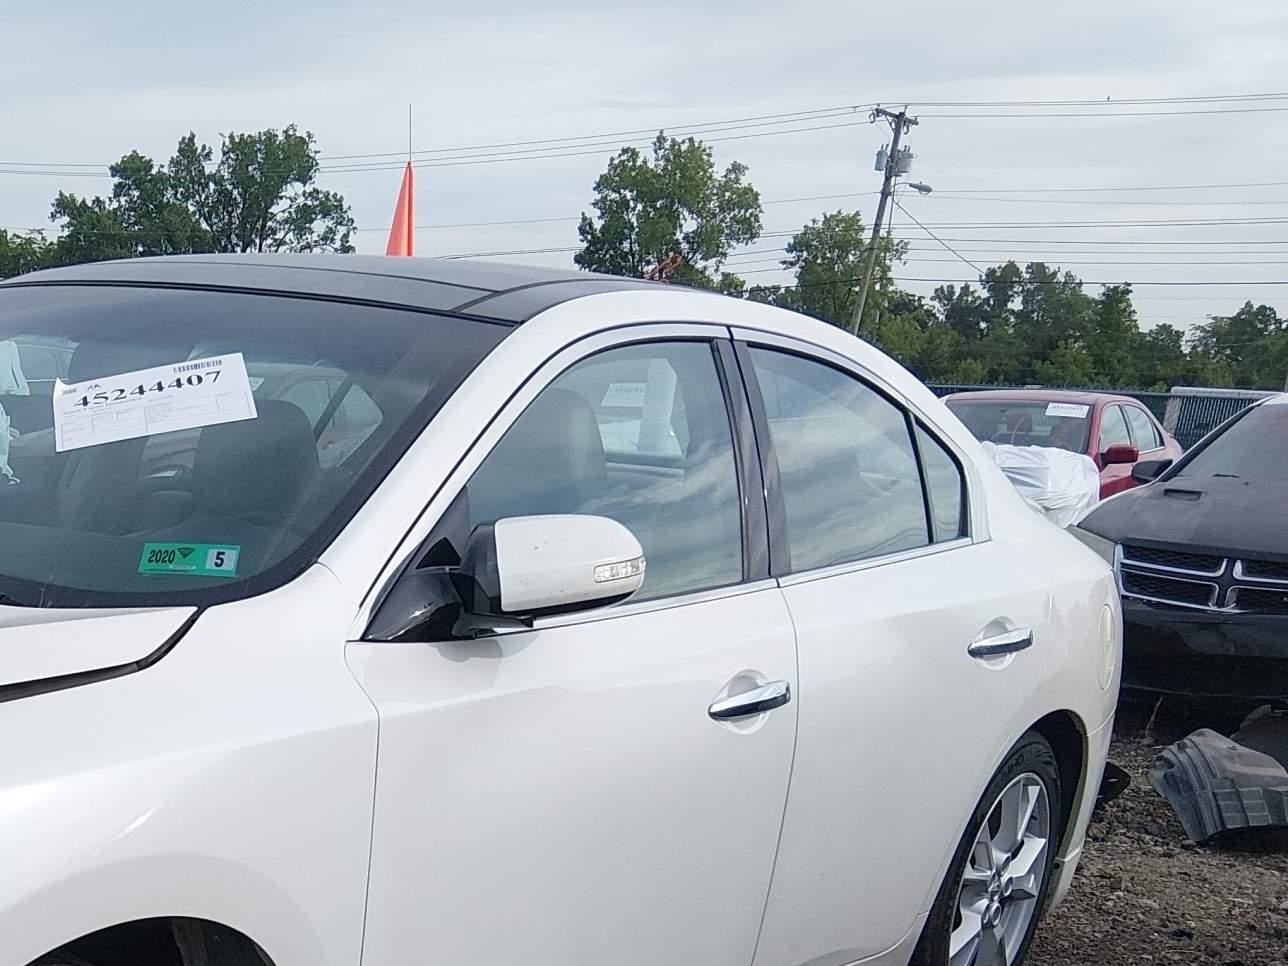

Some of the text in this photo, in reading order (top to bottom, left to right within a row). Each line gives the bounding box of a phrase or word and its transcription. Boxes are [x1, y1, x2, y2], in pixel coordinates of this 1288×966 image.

[72, 370, 222, 408] 45244407
[147, 549, 175, 565] 2020
[214, 551, 226, 568] 5
